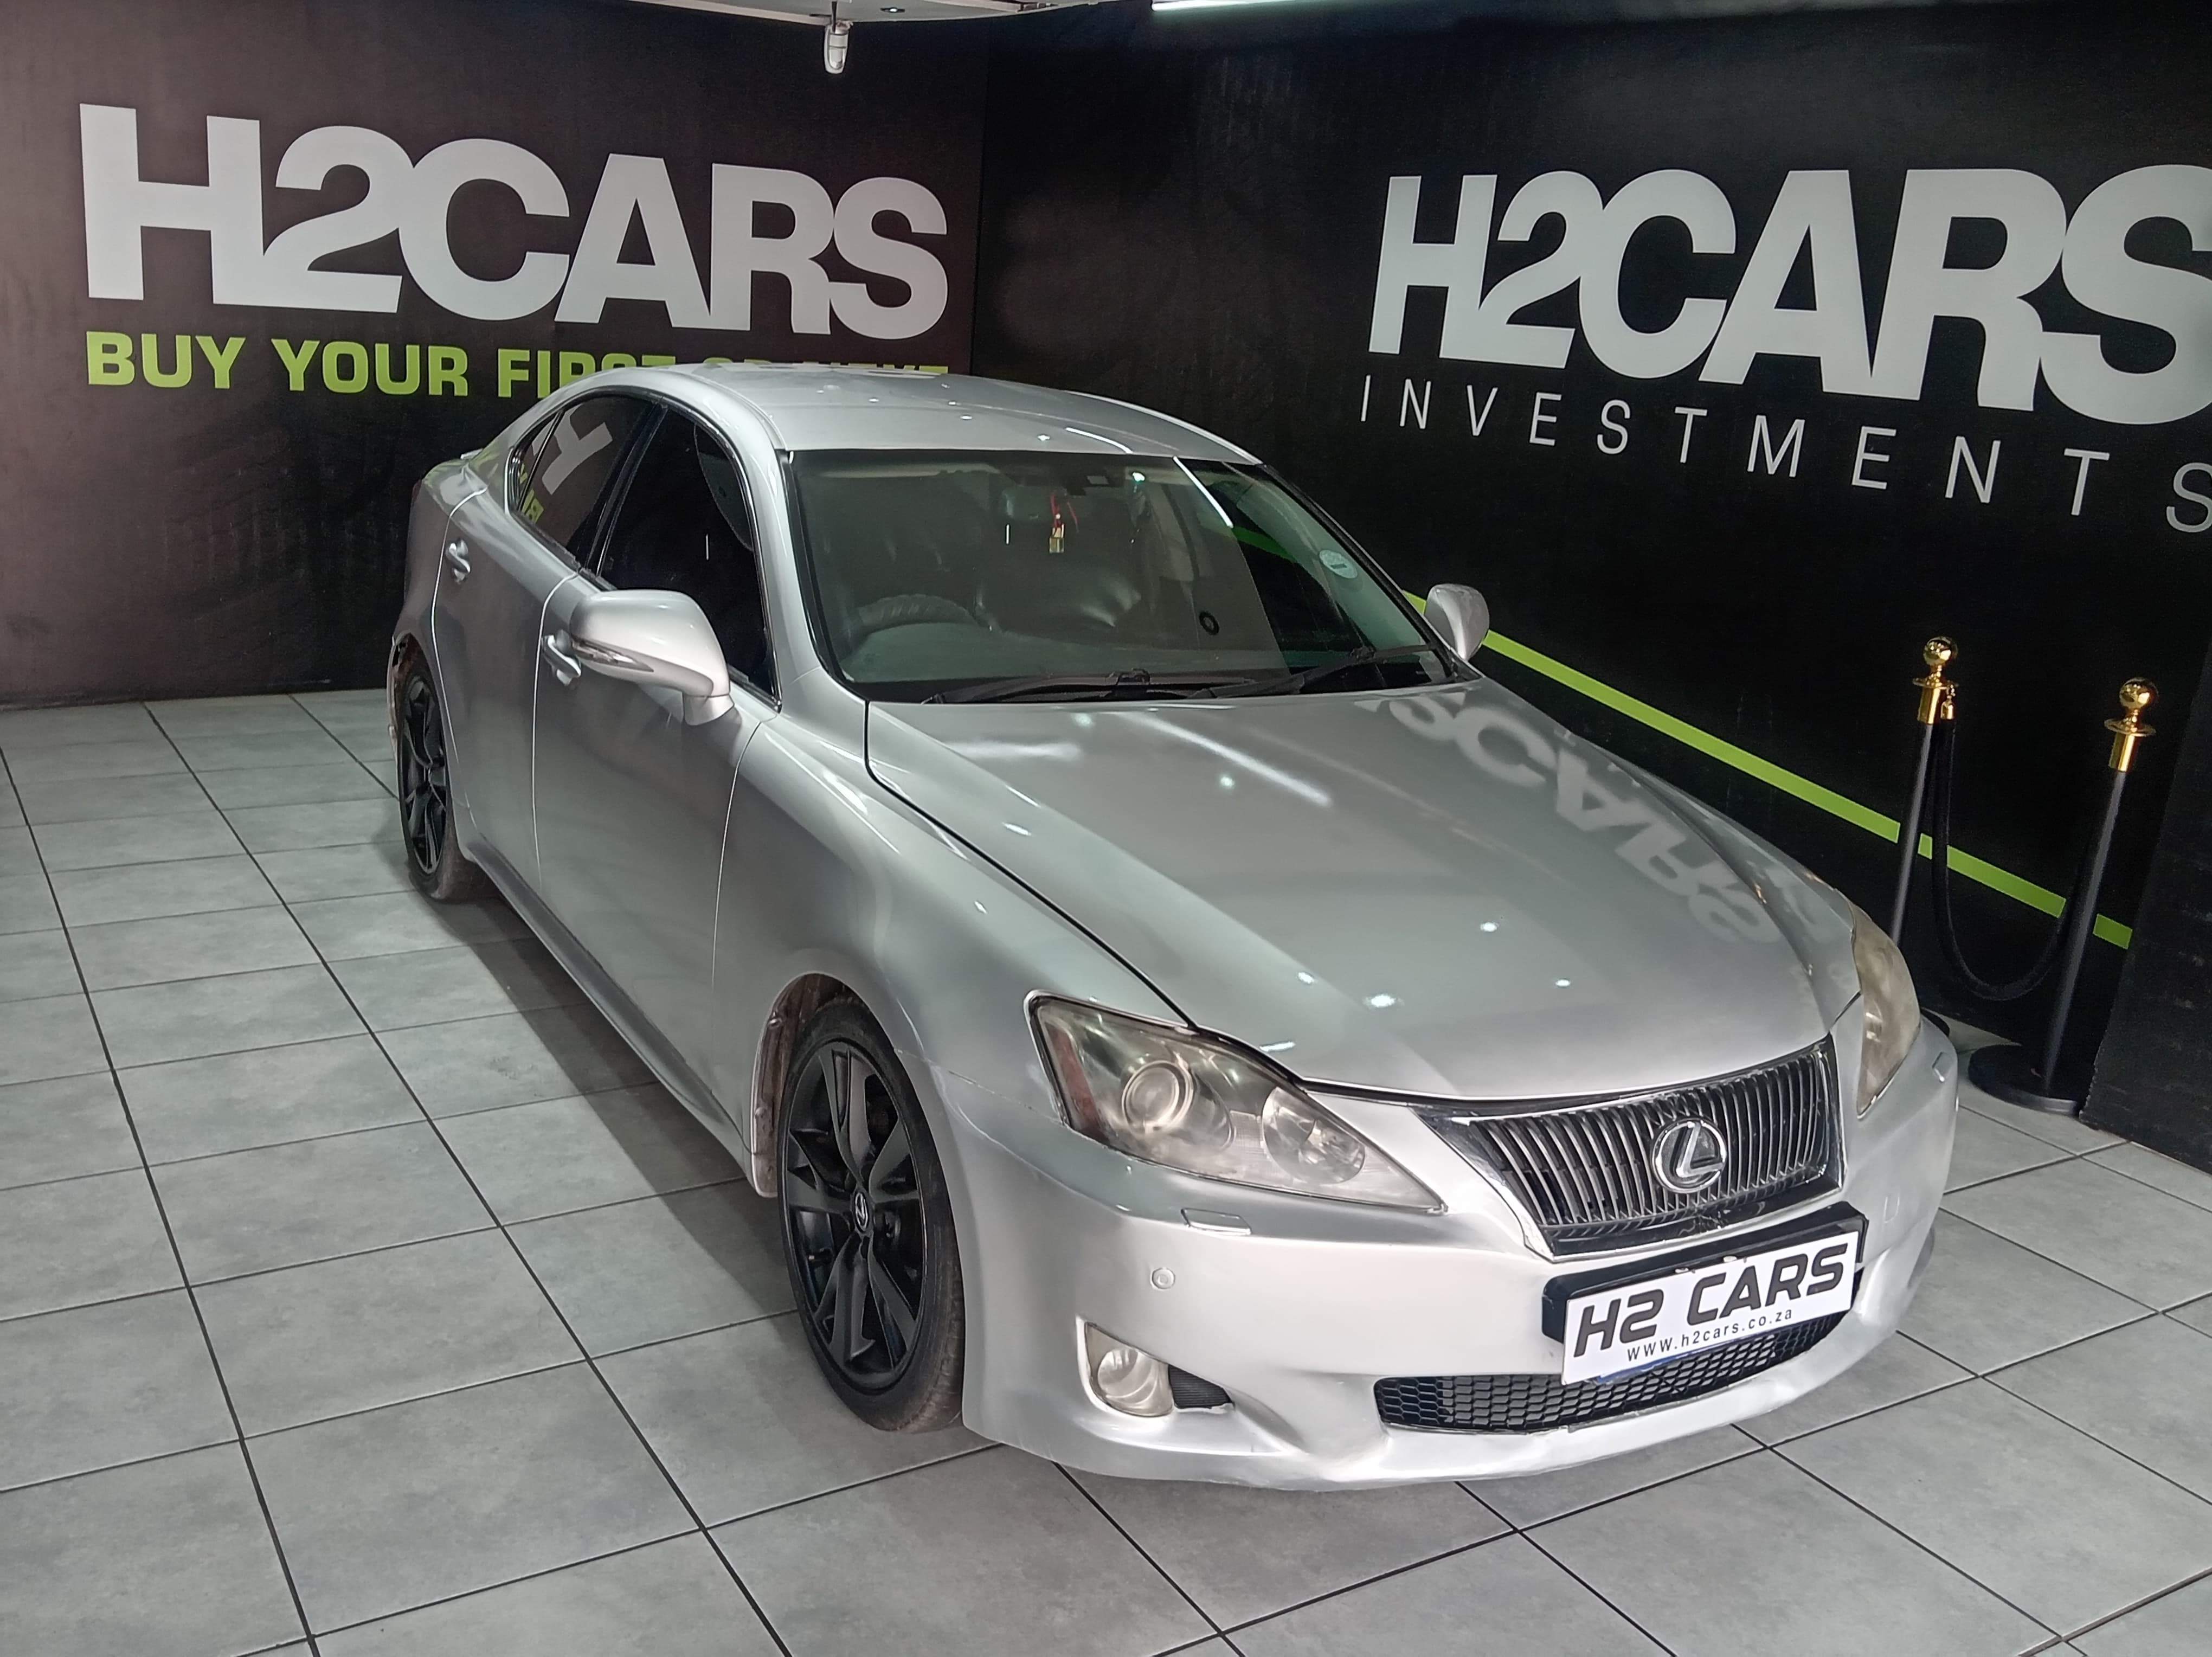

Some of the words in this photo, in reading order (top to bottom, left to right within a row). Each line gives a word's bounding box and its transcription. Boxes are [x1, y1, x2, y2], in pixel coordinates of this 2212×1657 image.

[80, 104, 948, 339] H2CARS
[1369, 164, 2212, 424] H2CARS
[86, 331, 245, 389] BUY
[273, 338, 468, 397] YOUR
[498, 348, 676, 399] FIR
[1361, 375, 2212, 532] INVESTMENTS
[1574, 1289, 1664, 1357] H2
[1687, 1243, 1848, 1326] CARS
